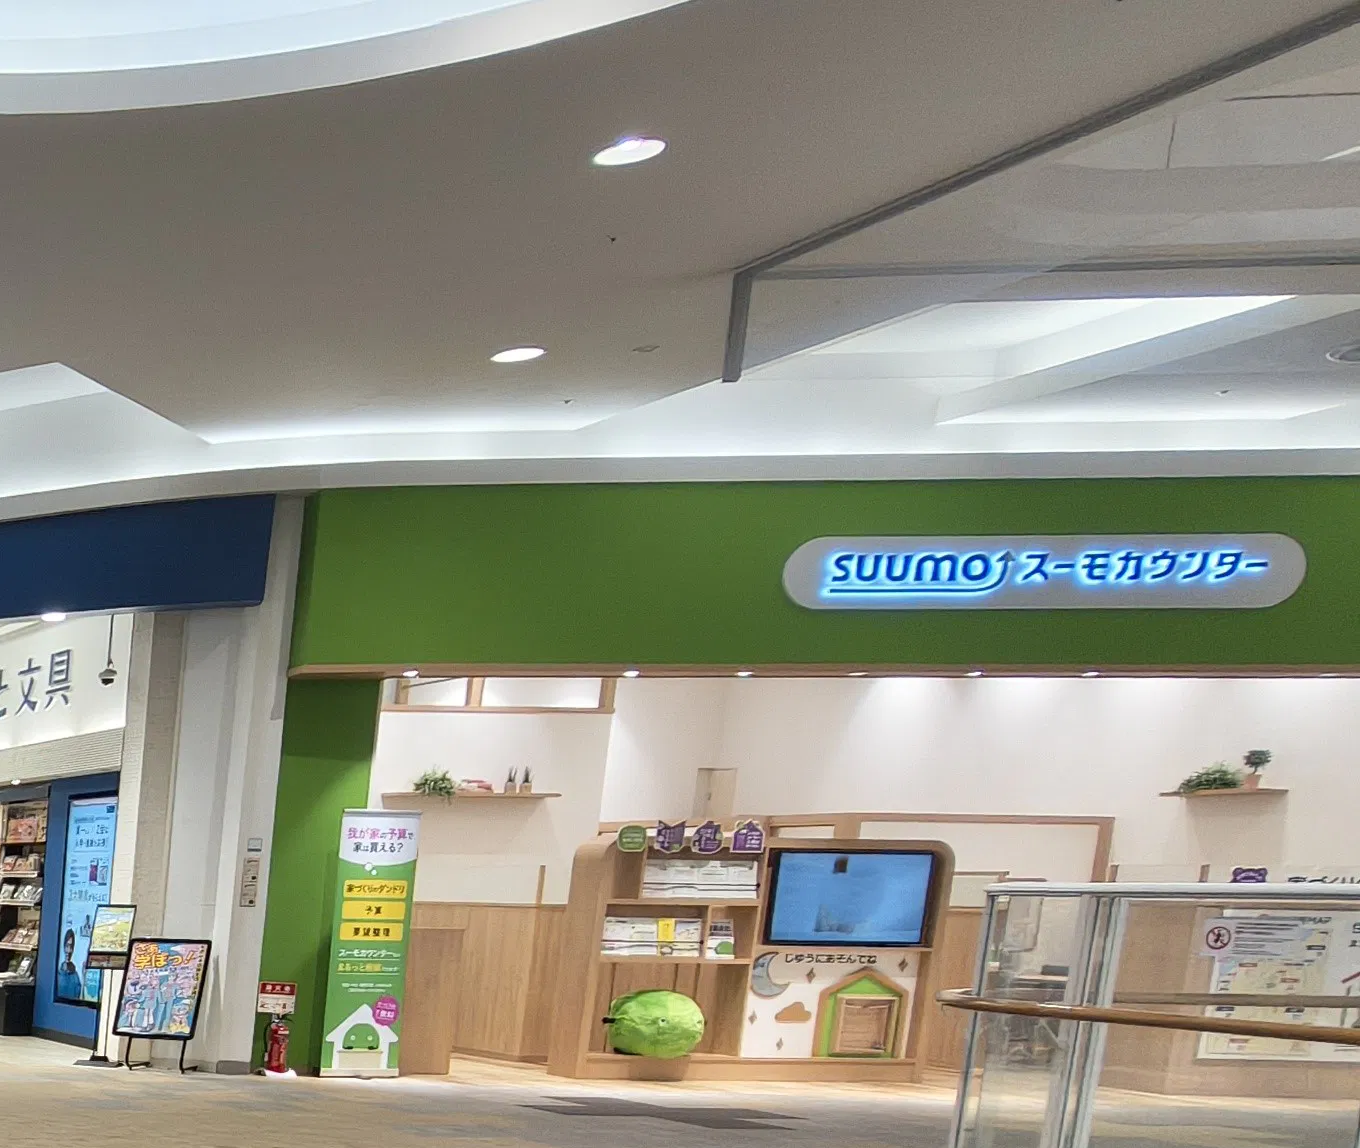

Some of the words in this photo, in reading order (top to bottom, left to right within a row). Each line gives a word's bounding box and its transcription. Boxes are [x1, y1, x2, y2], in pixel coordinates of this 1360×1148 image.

[1020, 549, 1269, 582] スーモカウンター
